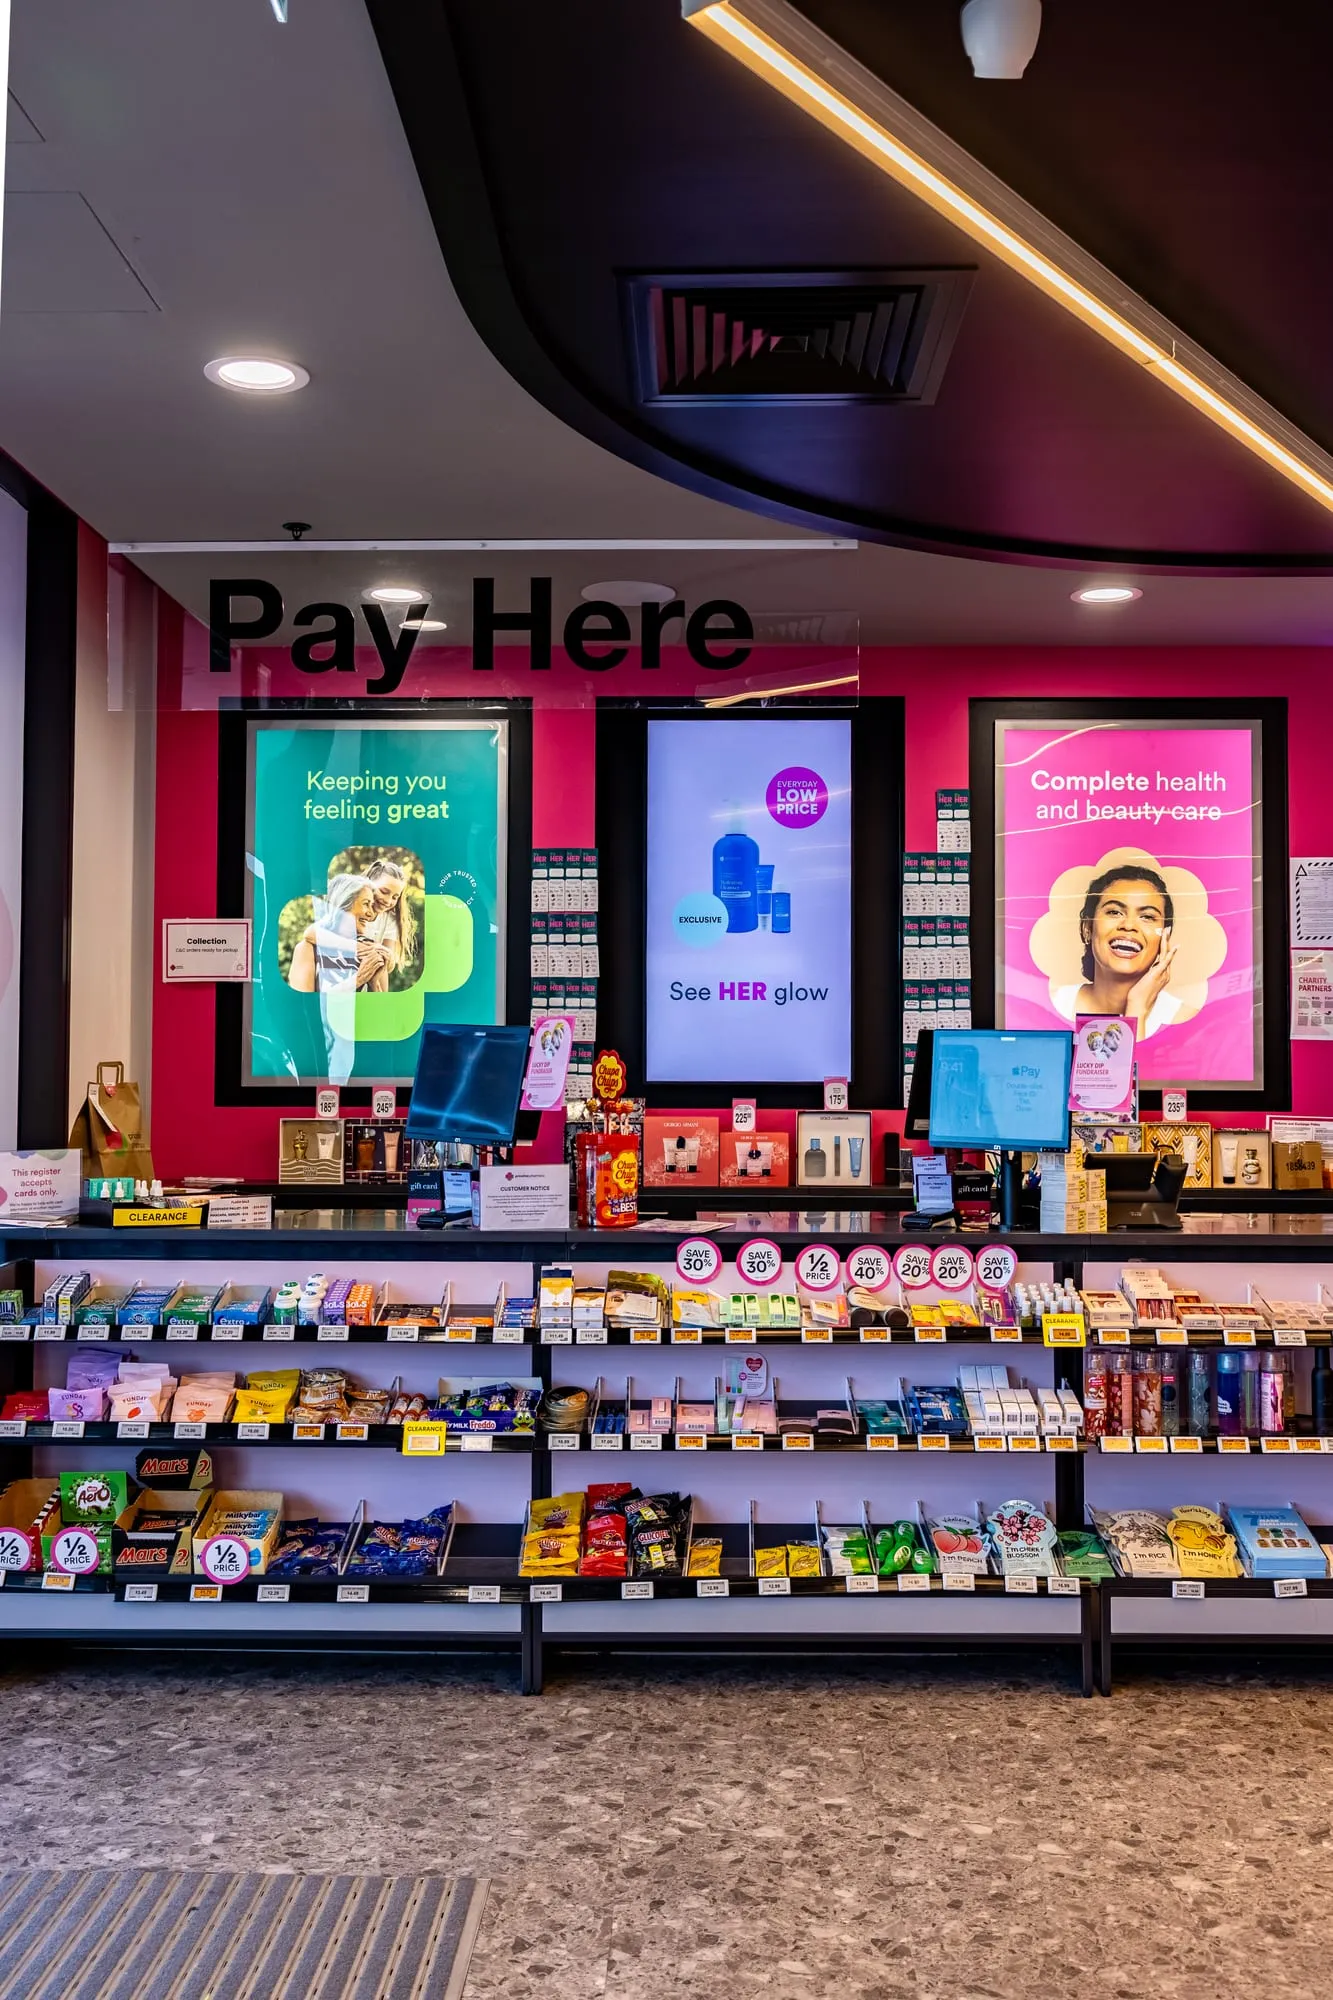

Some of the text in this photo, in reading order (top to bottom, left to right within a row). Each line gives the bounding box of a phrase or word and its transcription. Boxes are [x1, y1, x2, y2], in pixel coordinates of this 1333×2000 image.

[209, 577, 754, 694] Pay Here
[307, 770, 446, 795] Keeping you
[777, 780, 818, 788] EVERYDAY
[1031, 770, 1226, 795] Complete health
[776, 789, 818, 802] LOW
[304, 799, 449, 824] feeling great
[776, 803, 818, 814] PRICE
[1036, 799, 1222, 825] and beauty care
[679, 916, 722, 924] EXCLUSIVE
[670, 982, 828, 1005] See HER glow
[598, 1064, 620, 1077] Chupa
[1021, 1066, 1040, 1078] Pay
[597, 1076, 619, 1088] Chups
[30, 1168, 61, 1177] register
[20, 1179, 52, 1187] accepts
[410, 1182, 422, 1191] gift
[14, 1188, 59, 1197] cards only.
[958, 1185, 970, 1194] gift
[128, 1212, 188, 1222] CLEARANCE
[686, 1249, 710, 1258] SAVE
[748, 1251, 772, 1260] SAVE
[684, 1258, 712, 1271] 30%
[858, 1257, 882, 1266] SAVE
[906, 1254, 929, 1266] SAVE
[940, 1257, 964, 1265] SAVE
[984, 1257, 1008, 1265] SAVE
[747, 1259, 776, 1273] 30%
[901, 1264, 929, 1278] 20%
[854, 1266, 884, 1279] 40%
[939, 1266, 967, 1279] 20%
[983, 1266, 1011, 1279] 20%
[169, 1316, 194, 1325] extra
[220, 1316, 245, 1325] extra
[250, 1400, 276, 1408] FUNDAY
[470, 1420, 496, 1431] Freddo
[140, 1458, 210, 1476] Mars 2
[78, 1487, 110, 1504] Aero
[1243, 1514, 1259, 1526] 7
[0, 1556, 21, 1565] RICE
[64, 1556, 90, 1565] PRICE
[116, 1547, 188, 1566] Mars 2
[957, 1556, 983, 1564] PEACH
[1198, 1551, 1222, 1560] HONEY
[214, 1564, 240, 1572] PRICE
